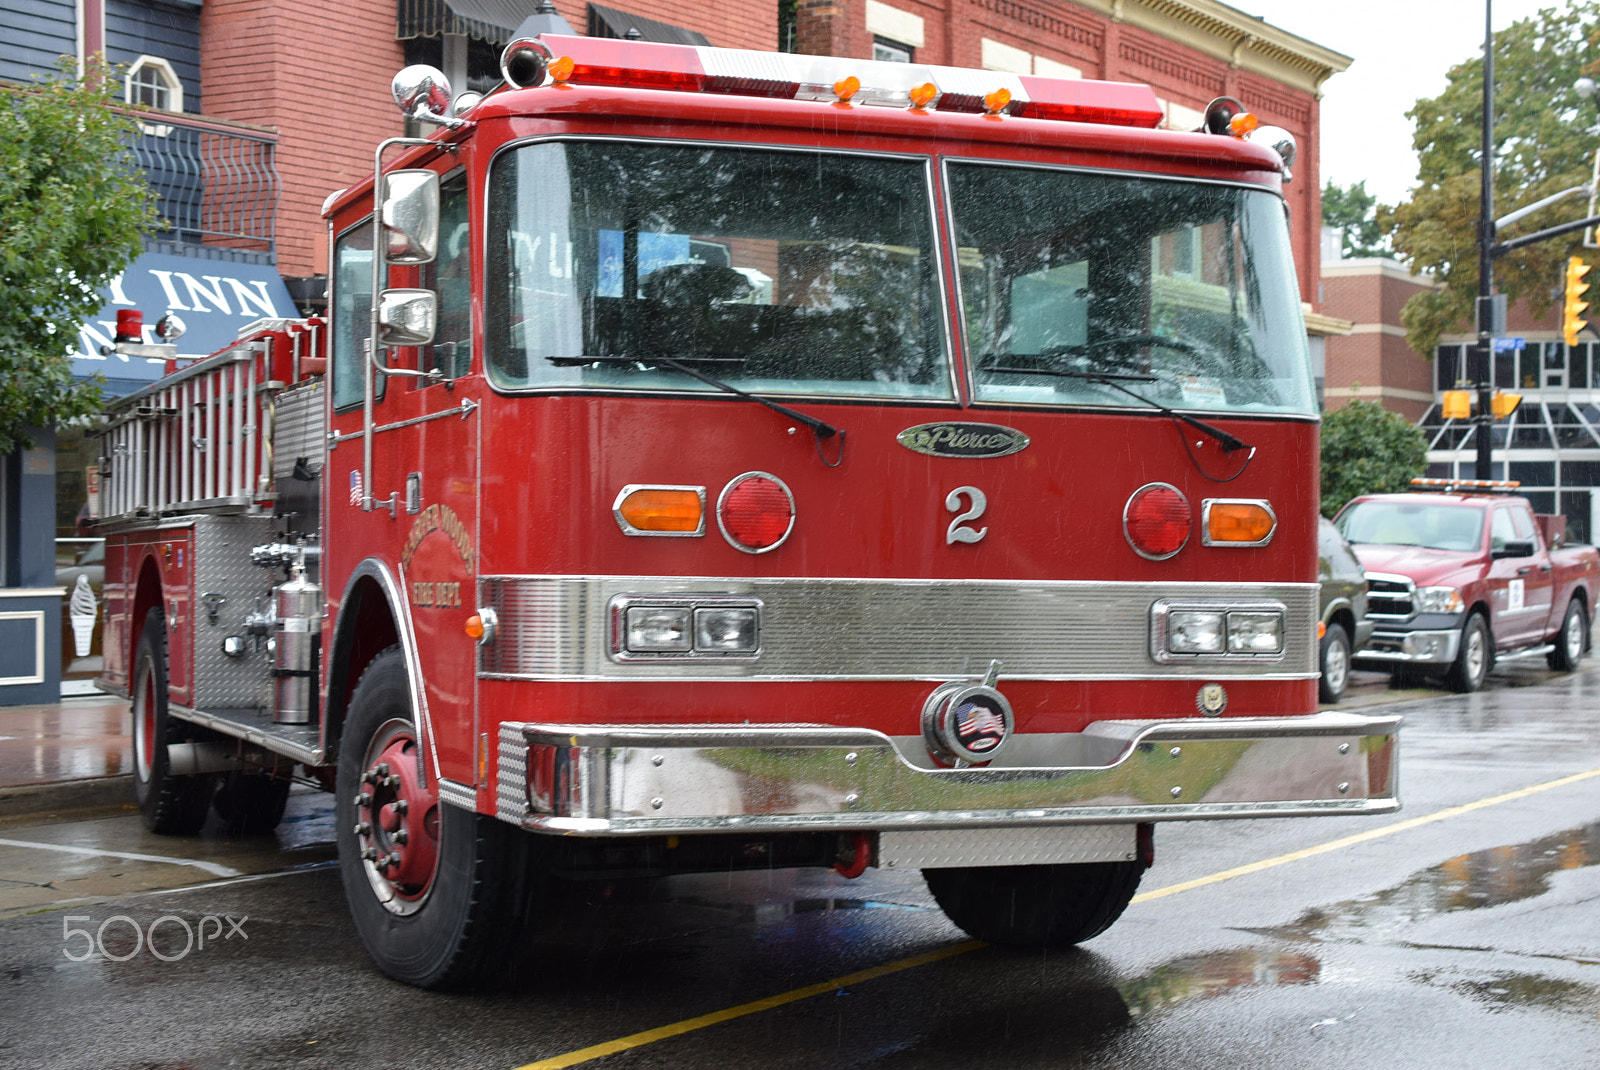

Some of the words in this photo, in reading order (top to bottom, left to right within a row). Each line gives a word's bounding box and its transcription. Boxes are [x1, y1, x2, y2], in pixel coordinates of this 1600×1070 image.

[148, 269, 278, 318] INN
[917, 426, 1003, 452] Pierce
[945, 485, 988, 545] 2
